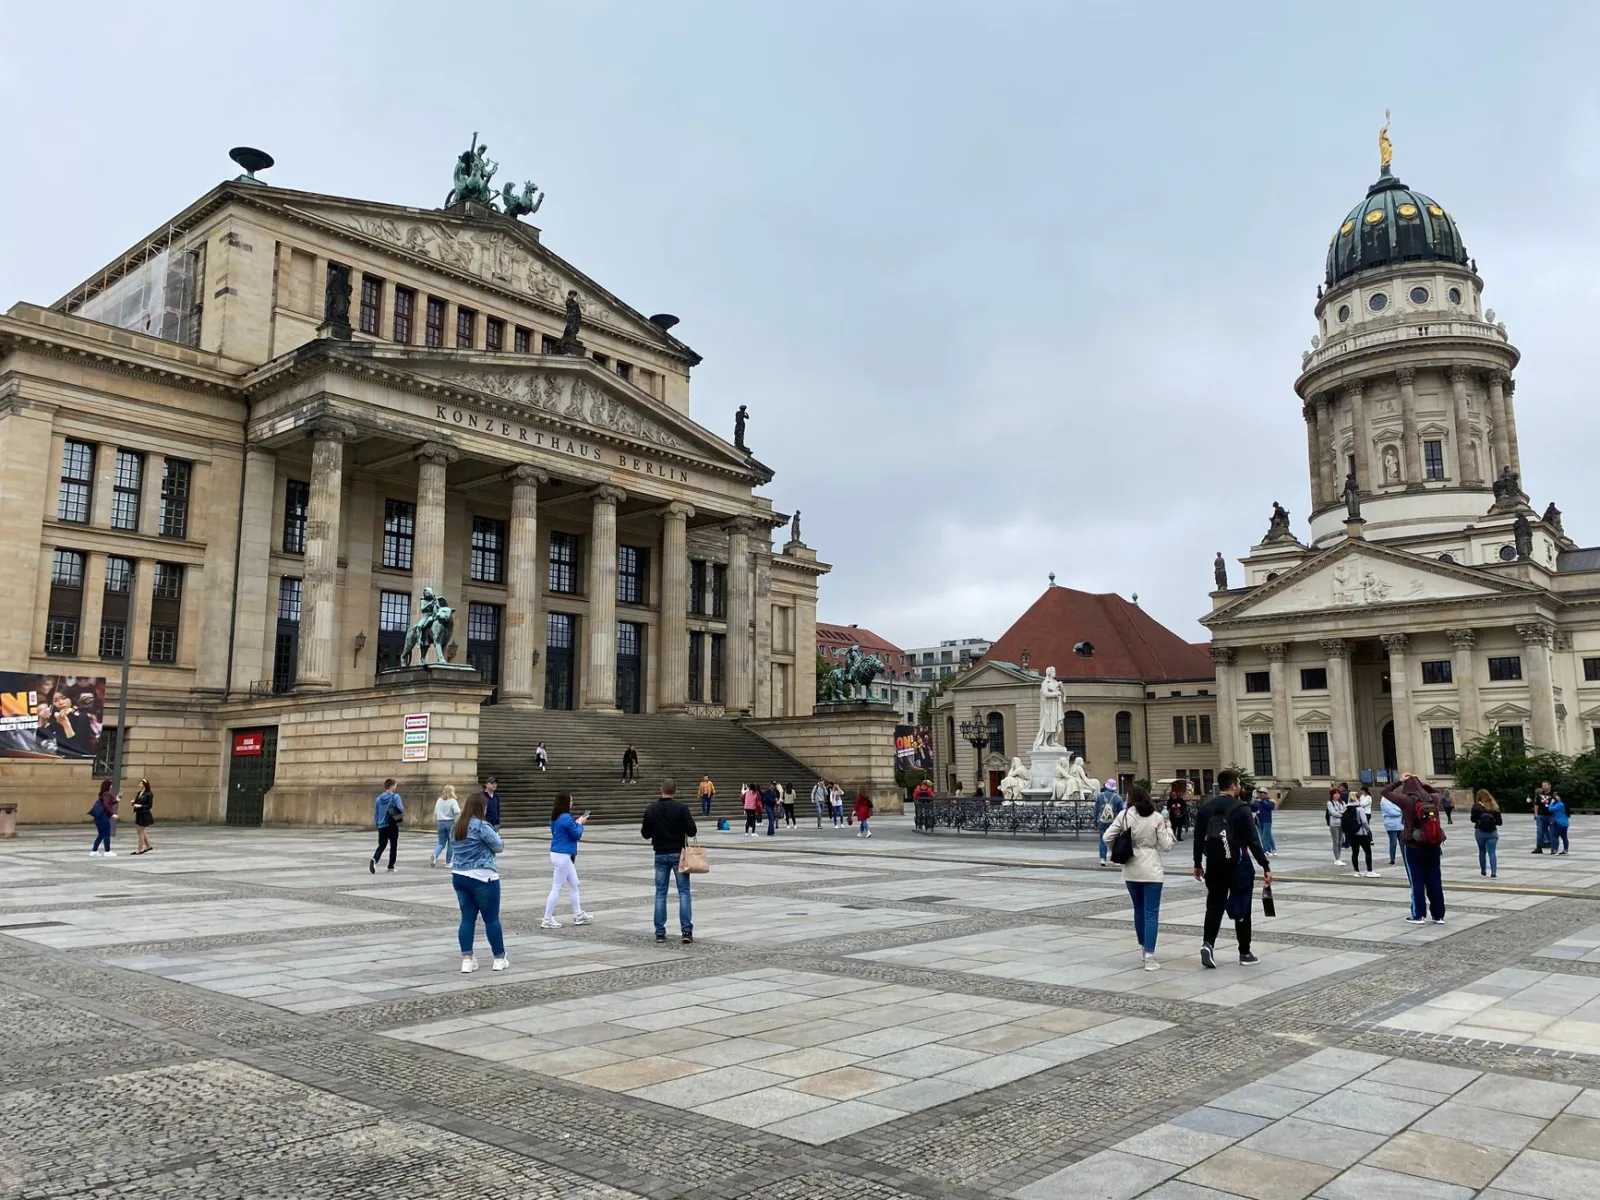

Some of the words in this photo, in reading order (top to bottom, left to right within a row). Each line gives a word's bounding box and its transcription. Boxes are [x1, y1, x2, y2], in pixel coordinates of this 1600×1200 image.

[436, 405, 602, 461] KONZERTHAUS
[619, 456, 689, 483] BERLIN
[0, 691, 38, 716] N!
